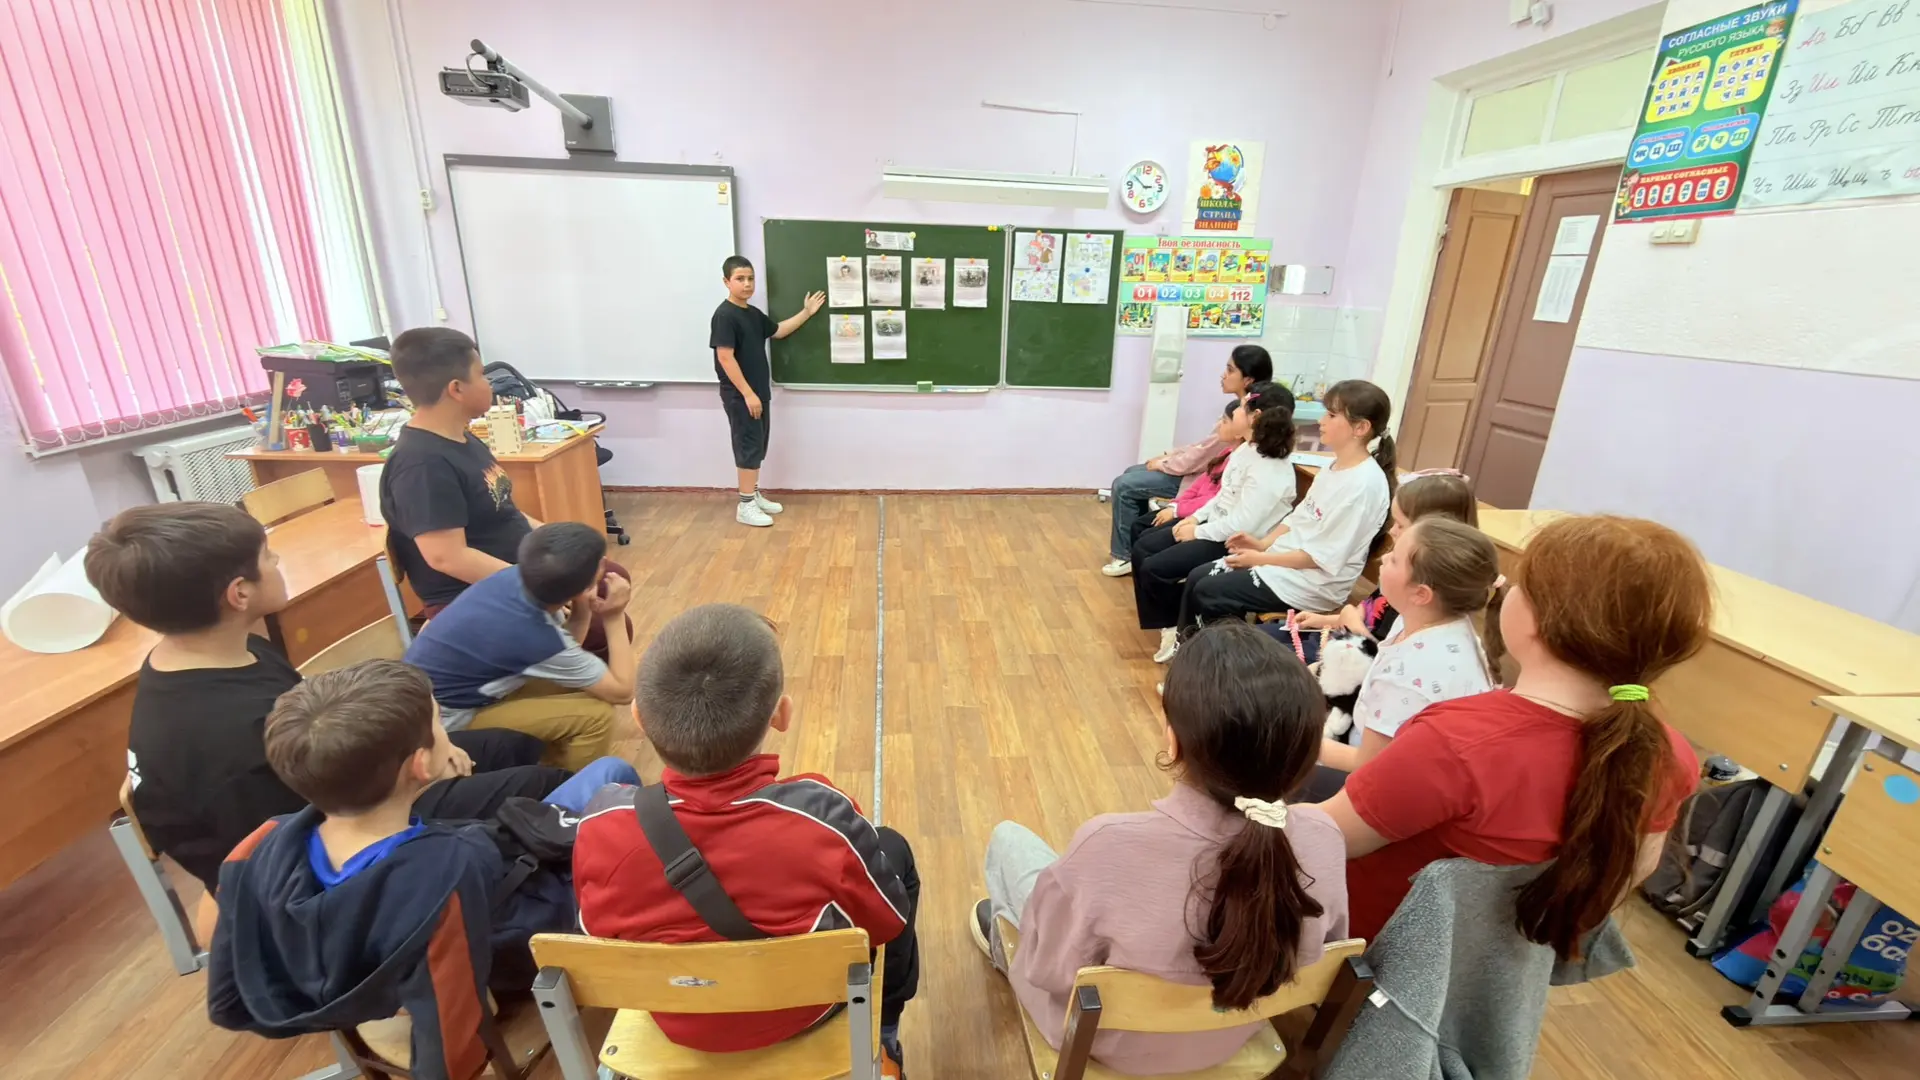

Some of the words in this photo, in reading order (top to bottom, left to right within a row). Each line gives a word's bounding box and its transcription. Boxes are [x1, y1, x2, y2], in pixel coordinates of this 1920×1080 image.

[1668, 19, 1739, 48] СОГЛАСНЫЕ
[1742, 3, 1787, 25] ЗВУКИ
[1834, 10, 1877, 39] Бб
[1877, 0, 1910, 28] Вв
[1677, 35, 1727, 57] РУССКОГО
[1728, 25, 1765, 42] ЯЗЫКА
[1780, 79, 1803, 104] Зз
[1808, 72, 1839, 93] Ии
[1764, 124, 1797, 146] Пп
[1803, 119, 1832, 147] Рр
[1837, 112, 1861, 135] Сс
[1142, 165, 1153, 175] 12
[1640, 173, 1672, 184] ПАРНЫЕ
[1674, 166, 1729, 180] СОГЛАСНЫЕ
[1126, 180, 1133, 190] 9
[1155, 175, 1162, 184] 2
[1753, 176, 1773, 194] Чч
[1782, 172, 1818, 192] Шш
[1827, 166, 1868, 188] Щщ
[1127, 190, 1134, 199] 8
[1139, 199, 1145, 208] 6
[1202, 210, 1236, 219] СТРАНА
[1158, 237, 1178, 248] Твоя
[1181, 238, 1241, 248] безопасность
[1134, 254, 1145, 265] 01
[1137, 287, 1152, 299] 01
[1161, 287, 1177, 299] 02
[1185, 287, 1201, 299] 03
[1208, 287, 1225, 299] 04
[1230, 291, 1250, 301] 112
